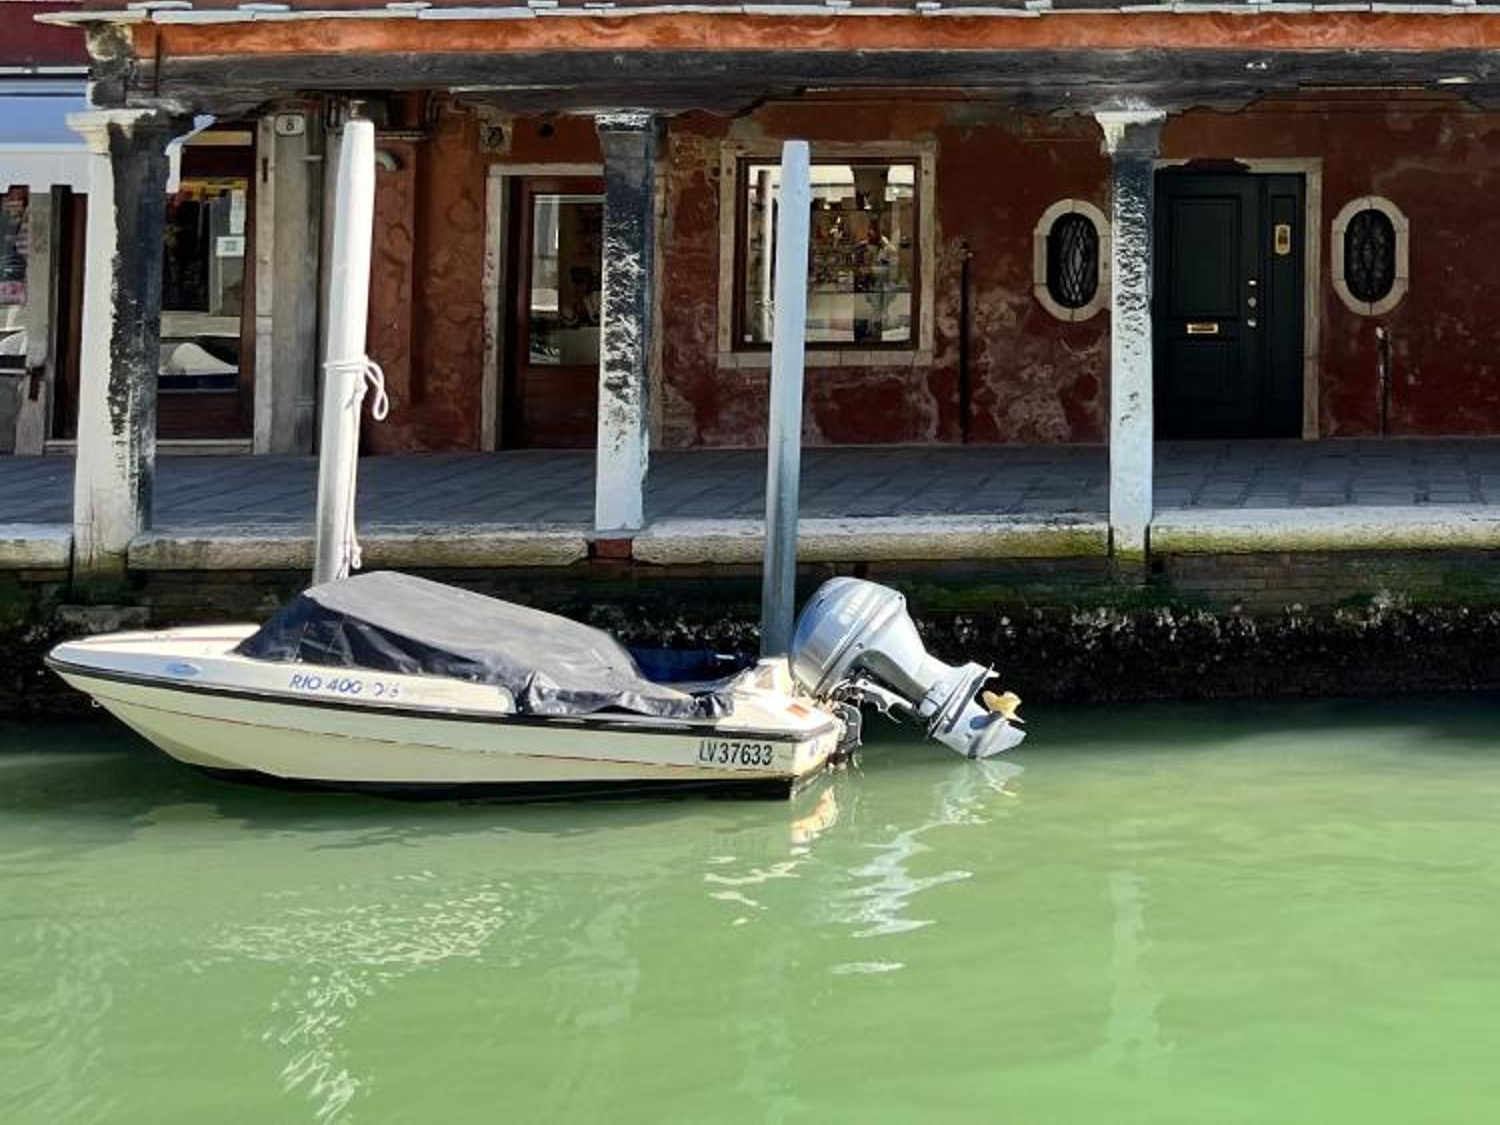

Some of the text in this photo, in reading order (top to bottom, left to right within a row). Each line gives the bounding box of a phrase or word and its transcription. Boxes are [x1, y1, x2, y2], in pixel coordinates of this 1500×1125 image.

[290, 674, 322, 690] RIO
[326, 678, 363, 694] 400
[699, 739, 774, 766] LV37633
